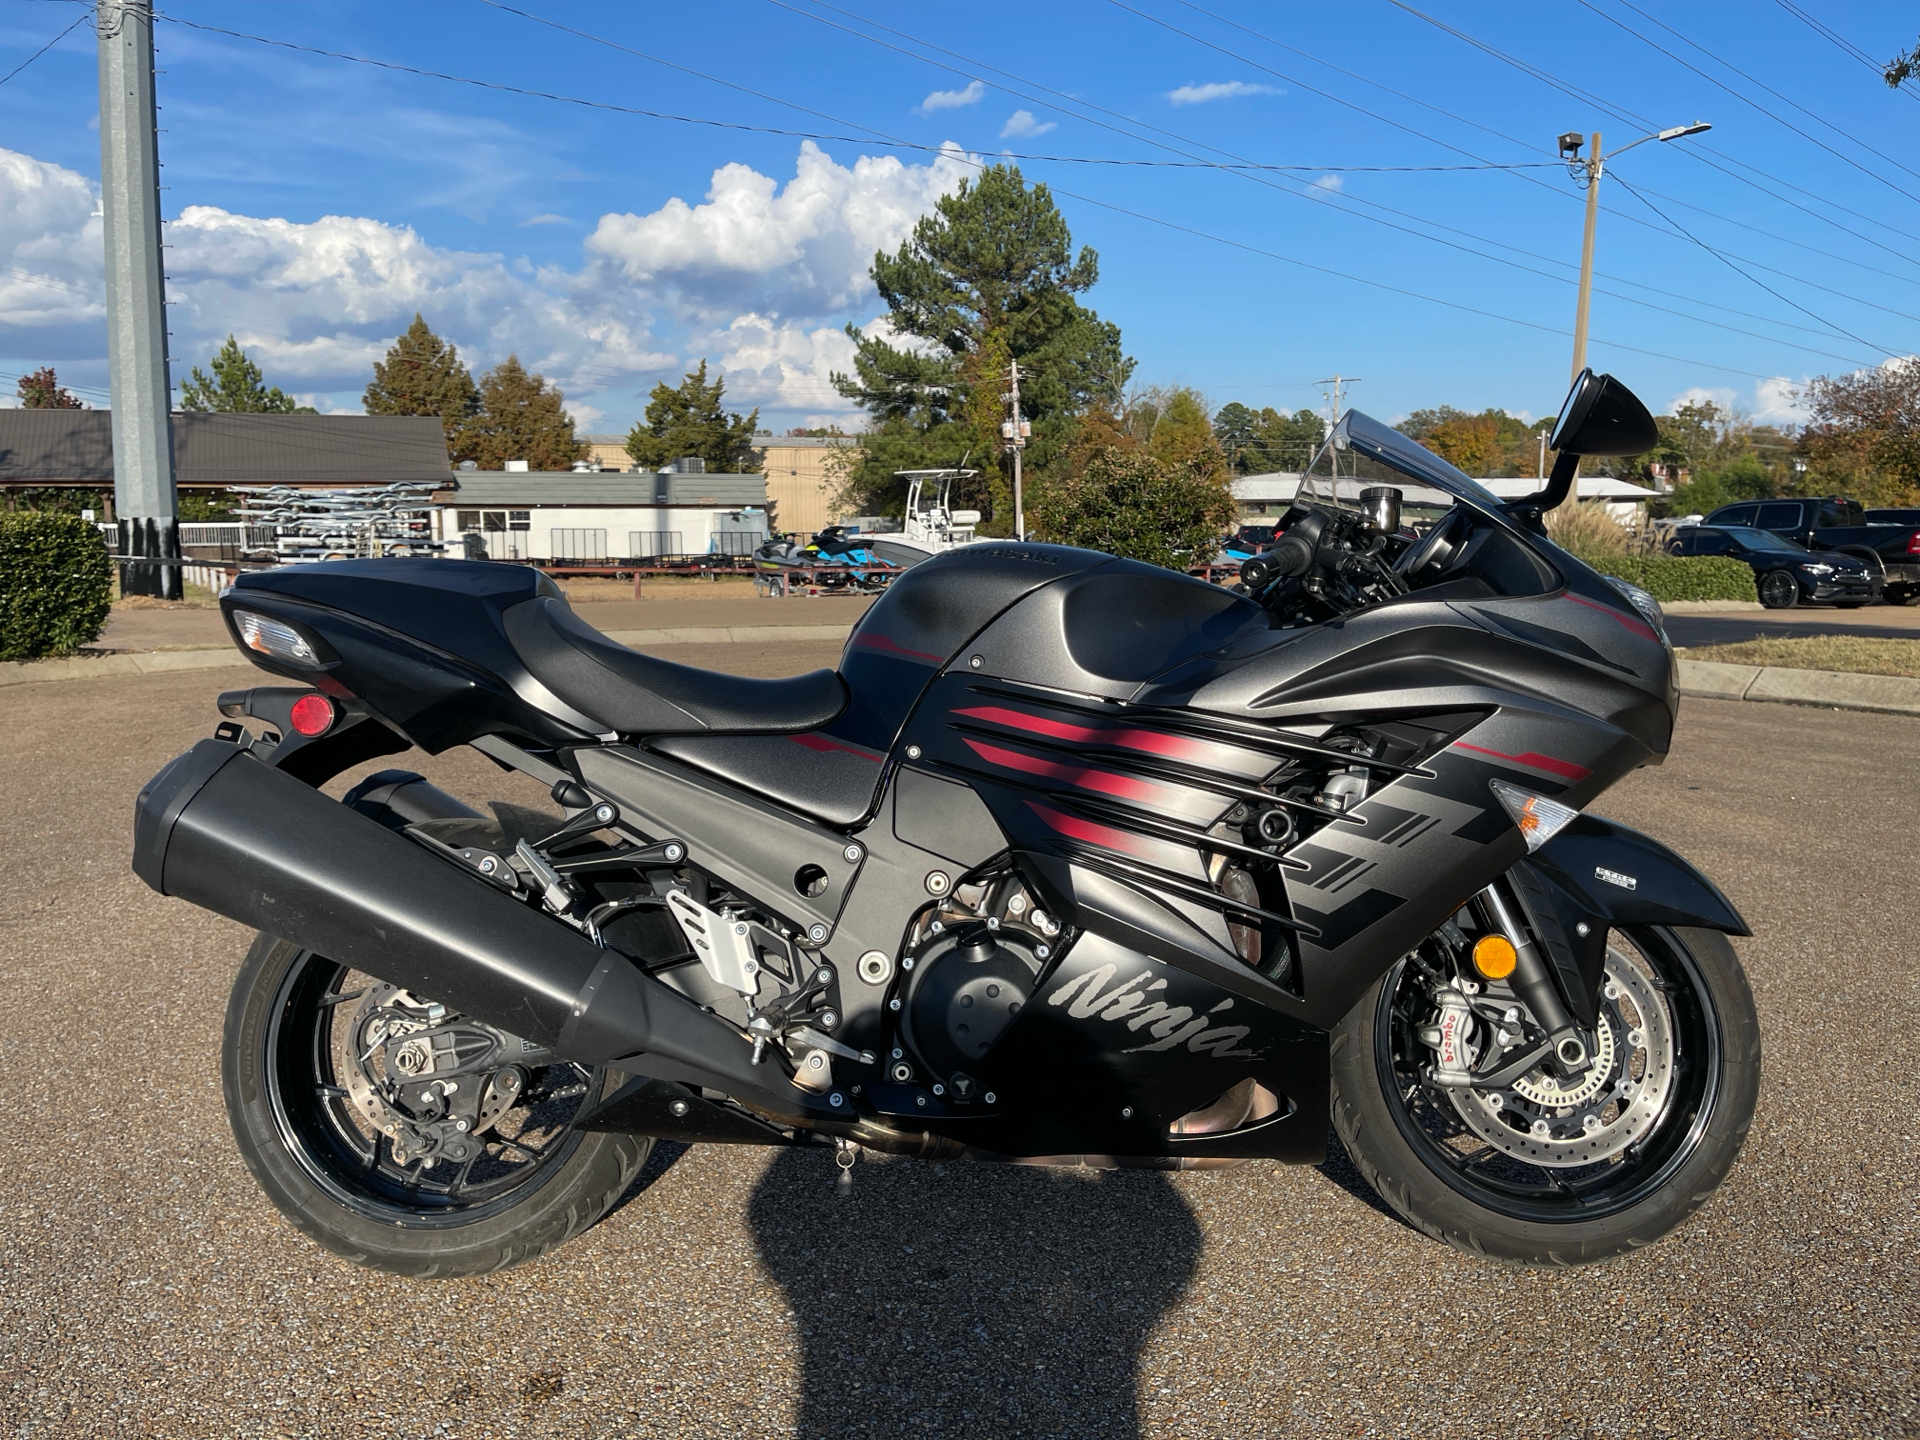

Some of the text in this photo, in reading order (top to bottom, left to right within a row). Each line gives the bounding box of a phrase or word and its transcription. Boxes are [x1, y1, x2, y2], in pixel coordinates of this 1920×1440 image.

[242, 998, 261, 1076] MICHELIN
[259, 950, 283, 988] ROAD
[1048, 963, 1254, 1059] Ninja
[1443, 1015, 1455, 1062] brembo
